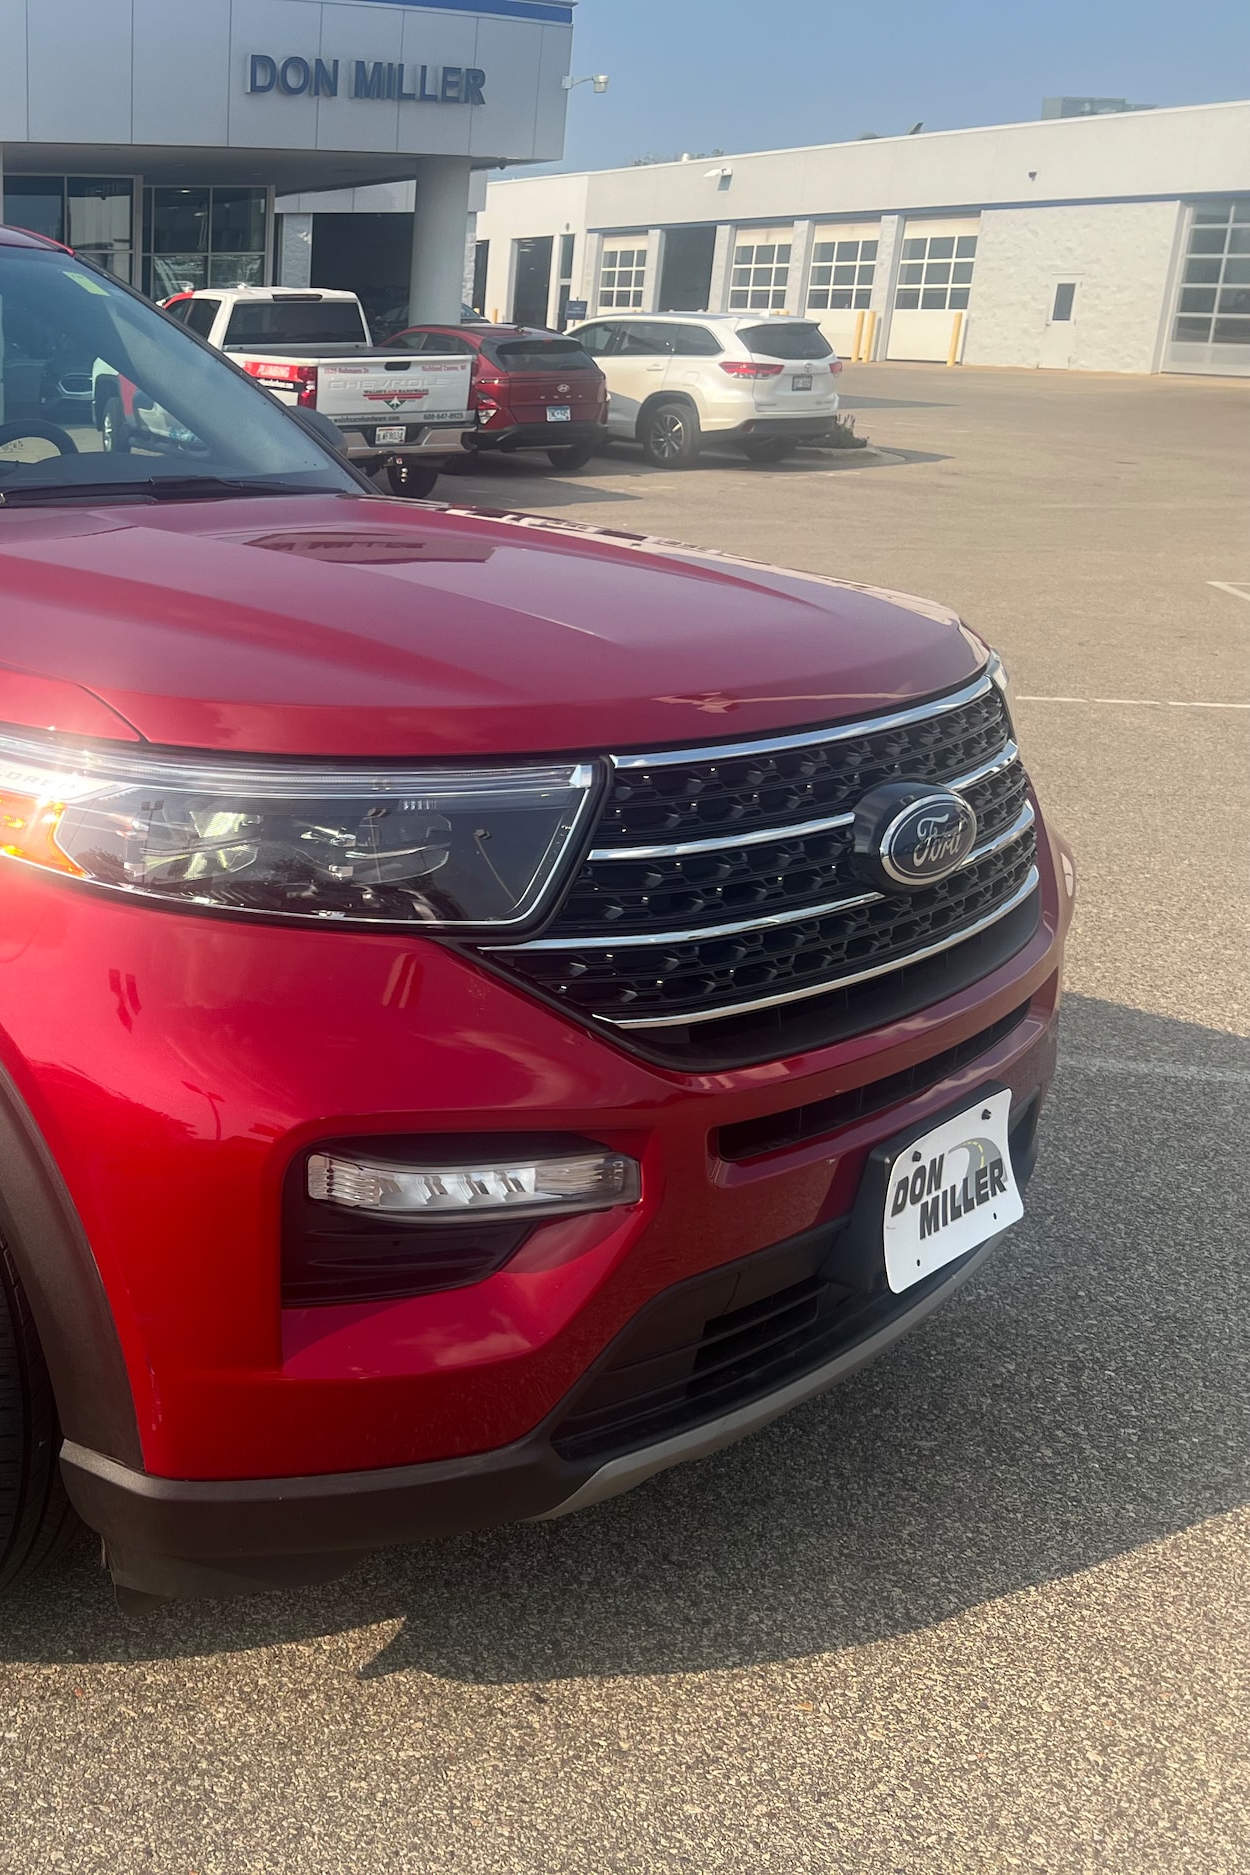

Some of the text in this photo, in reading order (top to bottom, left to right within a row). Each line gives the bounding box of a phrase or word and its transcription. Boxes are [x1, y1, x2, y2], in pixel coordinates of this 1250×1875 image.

[247, 53, 486, 105] DON MILLER
[257, 364, 290, 378] PLUMBING
[328, 378, 449, 391] CHEVROLE
[913, 813, 963, 867] Ford
[890, 1153, 945, 1218] DON
[919, 1157, 1007, 1240] MILLER
